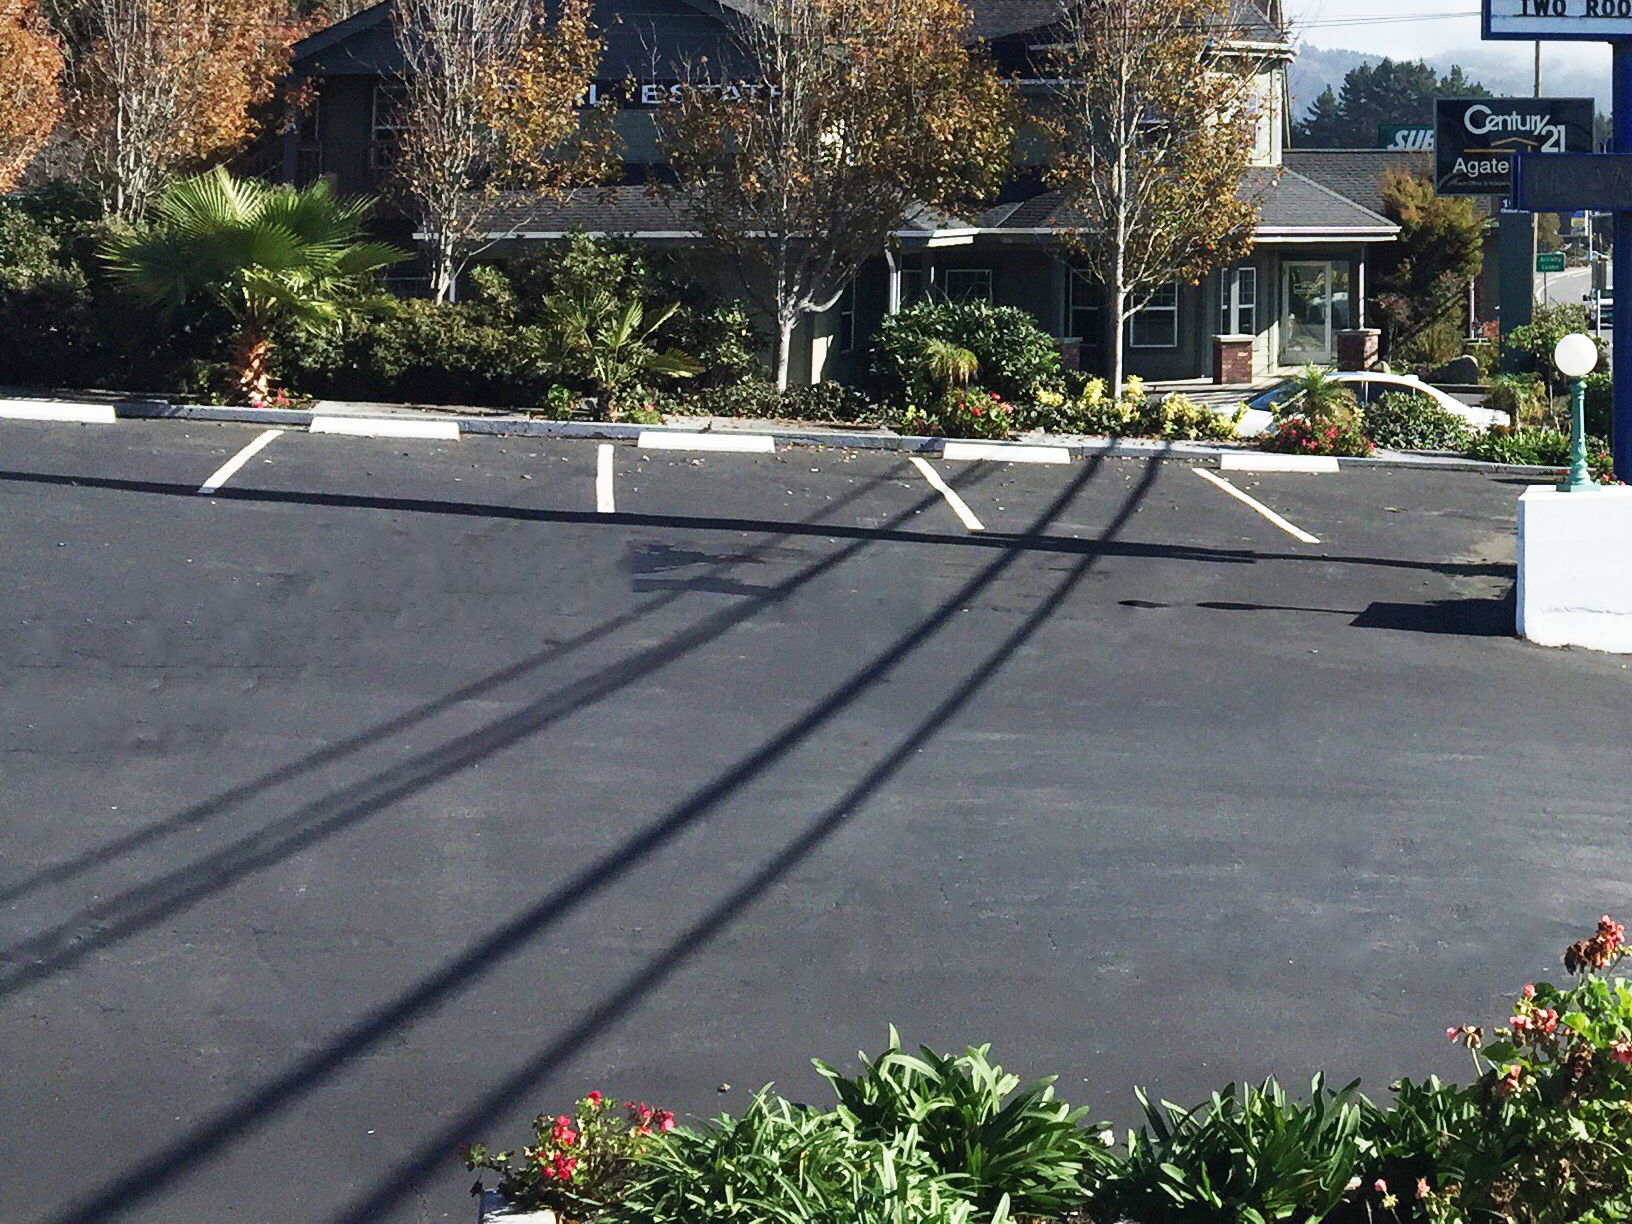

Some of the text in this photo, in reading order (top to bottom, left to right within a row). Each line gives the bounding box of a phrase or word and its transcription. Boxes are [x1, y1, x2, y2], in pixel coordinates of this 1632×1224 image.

[1464, 104, 1566, 153] Century 21
[1453, 157, 1510, 177] Agate
